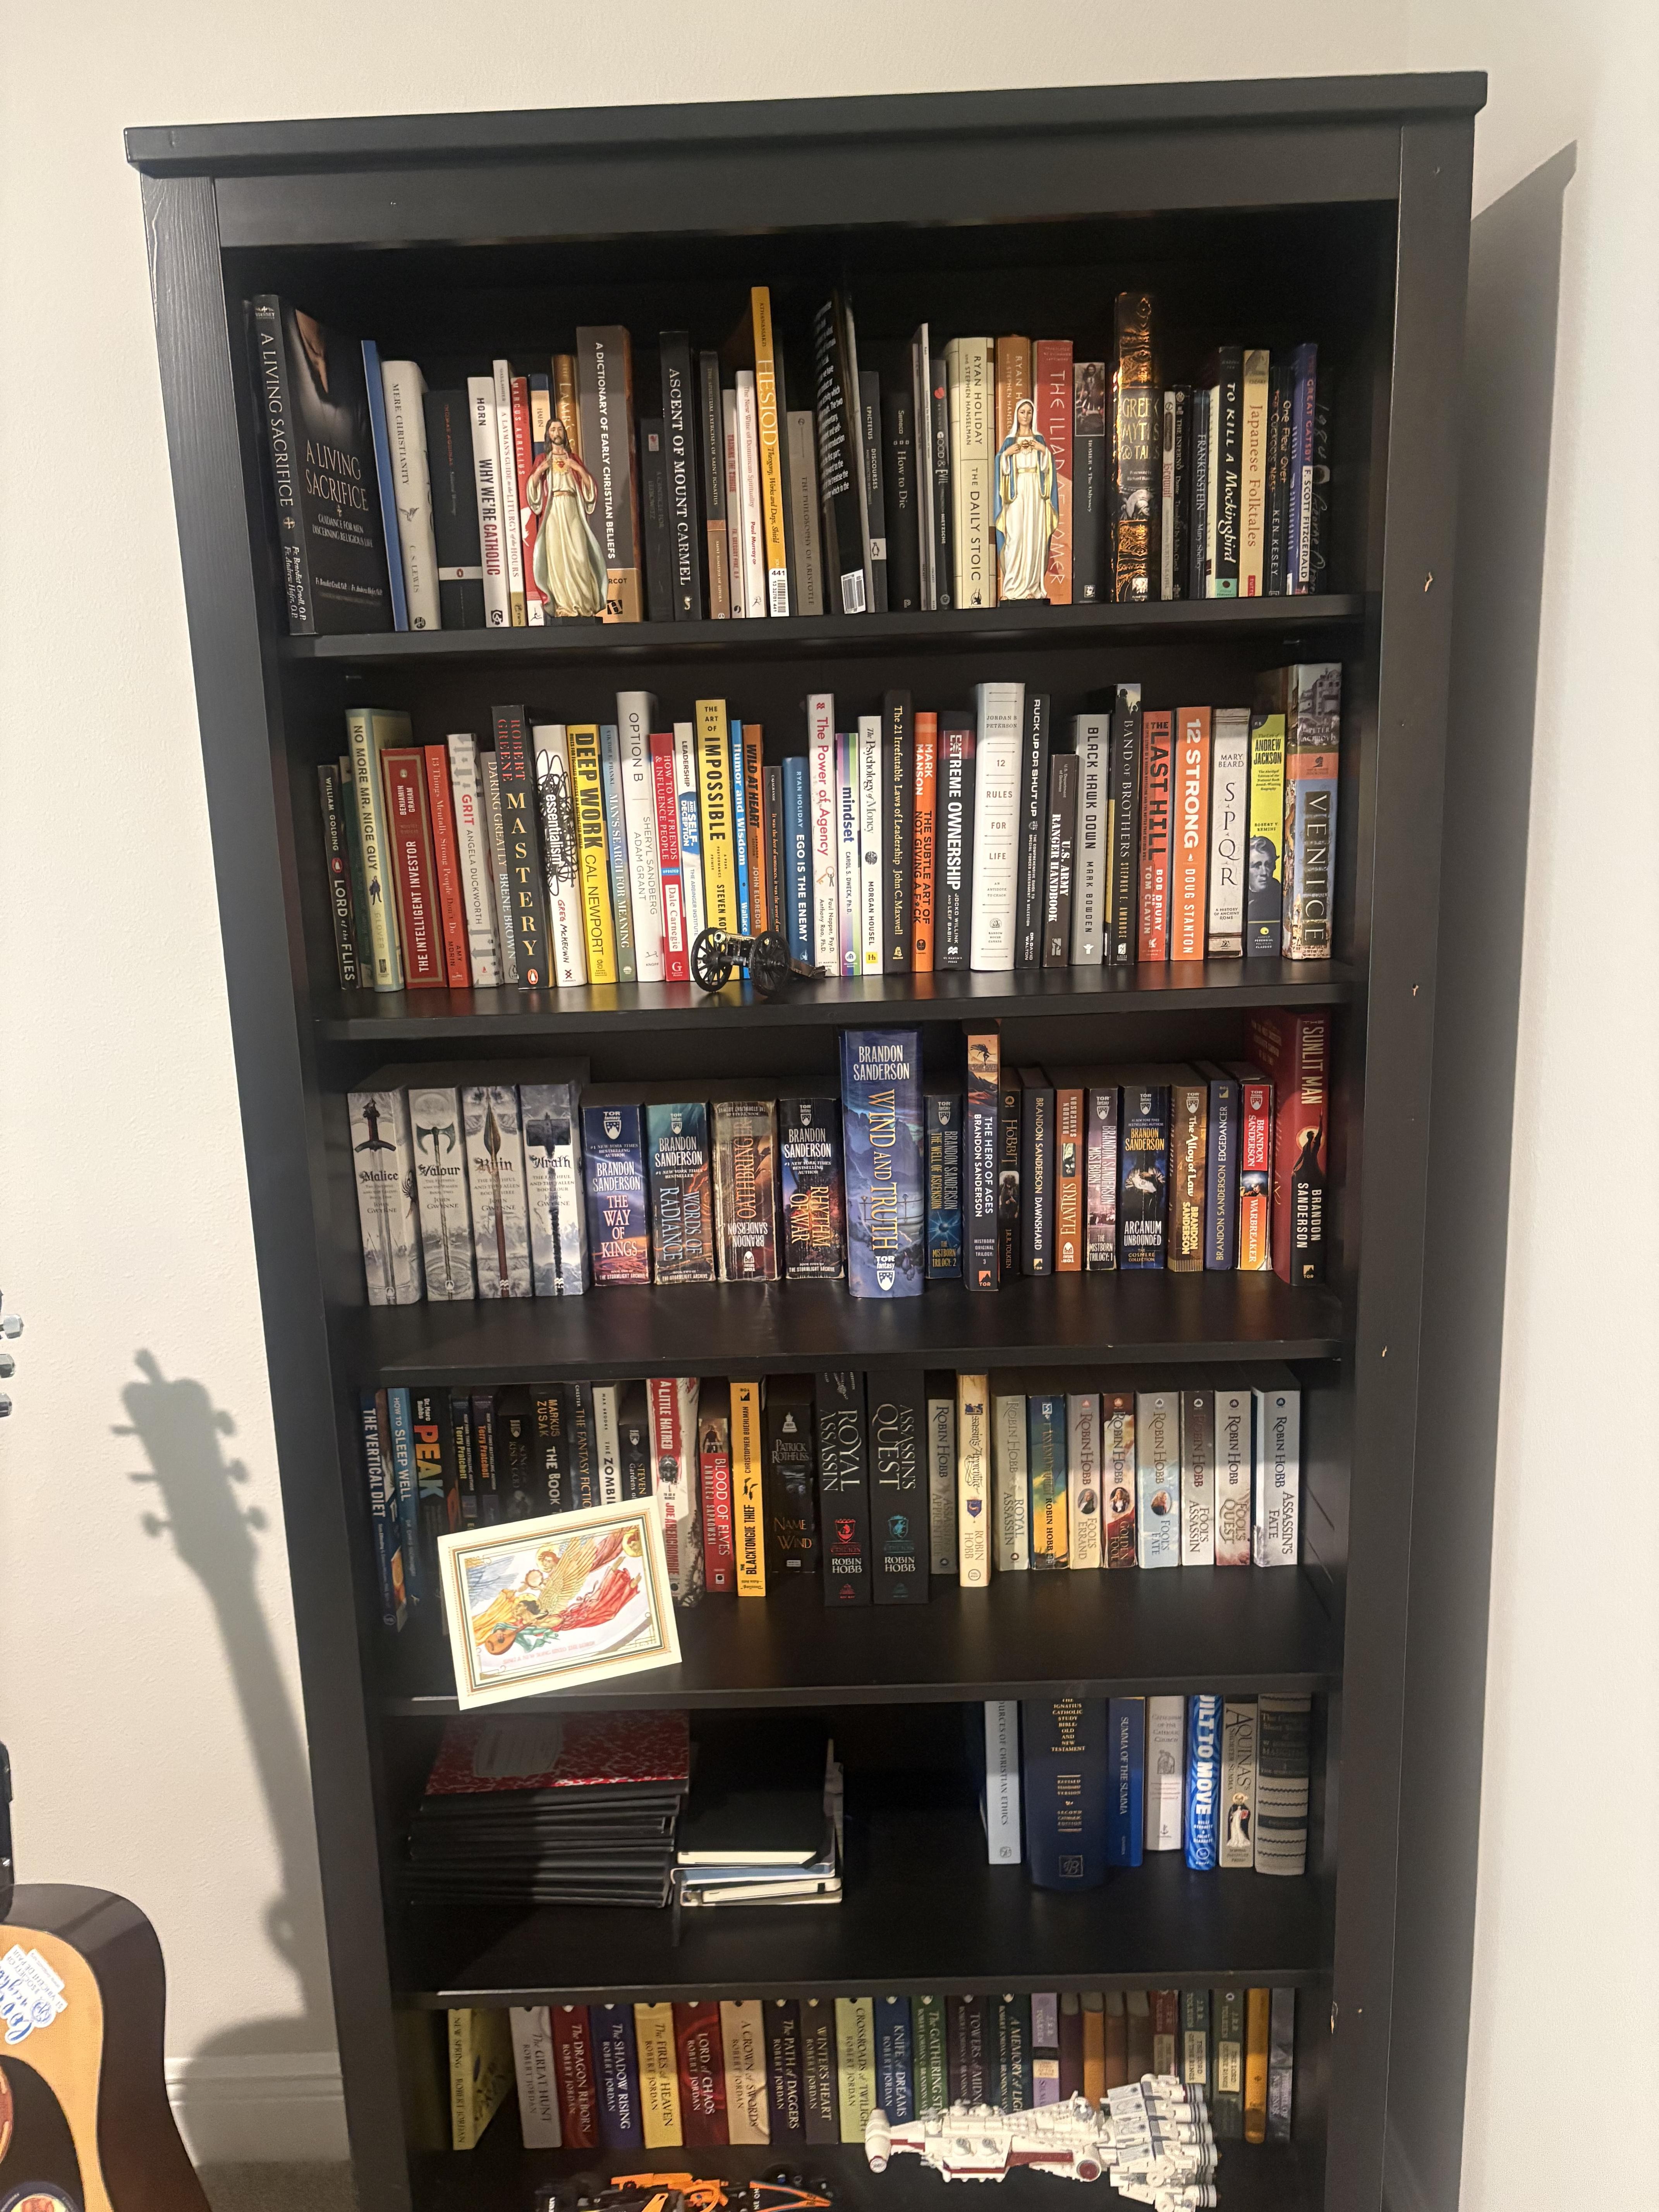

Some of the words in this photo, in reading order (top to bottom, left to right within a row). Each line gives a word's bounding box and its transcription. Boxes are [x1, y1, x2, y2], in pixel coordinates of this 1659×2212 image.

[261, 333, 274, 344] A
[262, 351, 282, 413] LIVING
[392, 384, 402, 412] MERE
[596, 352, 606, 414] DICTIONARY
[1227, 382, 1236, 402] TO
[477, 398, 486, 426] HORN
[669, 369, 683, 431] ASCENT
[757, 359, 778, 446] HESIOD
[600, 416, 608, 429] OF
[1226, 408, 1236, 448] KILL
[1249, 405, 1263, 472] Japanese
[271, 418, 294, 507] SACRIFICE
[395, 413, 409, 486] CHRISTIANITY
[601, 429, 611, 464] EARLY
[672, 436, 684, 455] OF
[897, 451, 907, 472] How
[1226, 453, 1235, 463] A
[479, 459, 492, 484] WHY
[674, 457, 687, 519] MOUNT
[898, 475, 905, 486] to
[1304, 469, 1311, 477] F.
[603, 466, 613, 520] CHRISTIAN
[970, 490, 981, 531] DAILY
[1302, 478, 1310, 508] SCOTT
[1218, 469, 1237, 564] Mockingbird
[1247, 477, 1261, 547] Folktales
[483, 524, 500, 575] CATHOLIC
[605, 522, 615, 559] BELIEFS
[677, 522, 691, 586] CARMEL
[1300, 510, 1310, 578] FITZGERALD
[970, 536, 982, 581] STOIC
[354, 725, 363, 742] NO
[629, 713, 642, 768] OPTION
[816, 717, 828, 740] The
[1187, 718, 1201, 744] 12
[1254, 739, 1281, 752] ANDREW
[575, 733, 596, 783] DEEP
[817, 745, 829, 785] Power
[1087, 727, 1098, 768] BLACK
[1253, 752, 1282, 765] JACKSON
[356, 748, 367, 783] MORE
[634, 773, 643, 782] B
[949, 734, 962, 798] EXTREME
[361, 787, 370, 809] MR.
[704, 737, 722, 840] IMPOSSIBLE
[819, 789, 829, 804] of
[1086, 774, 1097, 809] HAWK
[1183, 749, 1200, 848] STRONG
[364, 812, 374, 840] NICE
[462, 794, 475, 826] GRIT
[579, 788, 603, 849] WORK
[843, 787, 853, 843] mindset
[546, 794, 562, 865] essentialism
[796, 834, 805, 860] EGO
[817, 808, 830, 856] Agency
[947, 802, 962, 890] OWNERSHIP
[1085, 815, 1097, 849] DOWN
[368, 845, 378, 870] GUY
[406, 841, 418, 888] INVESTOR
[466, 830, 476, 866] ANGELA
[506, 793, 537, 955] MASTERY
[586, 855, 596, 883] CAL
[797, 864, 805, 874] IS
[798, 876, 806, 896] THE
[1304, 794, 1327, 945] VENICE
[471, 868, 482, 924] DUCKWORTH
[668, 888, 677, 907] Dale
[334, 880, 348, 917] LORD
[341, 944, 355, 981] FLIES
[413, 891, 426, 944] INTELLIGENT
[587, 886, 604, 955] NEWPORT
[669, 910, 678, 950] Carnegie
[798, 899, 807, 942] ENEMY
[419, 947, 429, 973] THE
[858, 1045, 903, 1063] BRANDON
[1302, 1025, 1324, 1072] SUNLIT
[853, 1063, 910, 1081] SANDERSON
[1301, 1075, 1323, 1104] MAN
[868, 1089, 896, 1148] WIND
[1034, 1097, 1044, 1143] BRANDON
[873, 1152, 892, 1180] AND
[985, 1170, 993, 1185] OF
[1034, 1144, 1043, 1193] SANDERSON
[603, 1210, 630, 1225] WAY
[607, 1195, 629, 1208] THE
[871, 1182, 898, 1250] TRUTH
[985, 1188, 993, 1214] AGES
[612, 1226, 625, 1239] OF
[1034, 1197, 1042, 1250] DAWNSHARD
[1123, 1234, 1162, 1246] UNBOUNDED
[1124, 1221, 1162, 1234] ARCANUM
[1249, 1199, 1258, 1263] WARBREAKER
[601, 1242, 637, 1258] KINGS
[414, 1425, 445, 1499] PEAK
[819, 1409, 838, 1491] ASSASSIN
[838, 1410, 862, 1492] ROYAL
[715, 1458, 727, 1501] BLOOD
[717, 1504, 729, 1526] OF
[744, 1505, 755, 1527] THIEF
[1268, 1509, 1278, 1539] FATE
[718, 1529, 730, 1556] ELVES
[745, 1529, 757, 1575] BLACKTONGUE
[1120, 1717, 1129, 1748] SUMMA
[1199, 1695, 1215, 1736] UILT
[1120, 1750, 1128, 1762] OF
[1197, 1740, 1213, 1758] TO
[1119, 1782, 1128, 1815] SUMMA
[1195, 1762, 1213, 1815] MOVE
[612, 2024, 623, 2040] The
[894, 2025, 905, 2057] KNIFE
[603, 2041, 612, 2073] ROBERT
[615, 2041, 627, 2091] SHADOW
[898, 2059, 902, 2069] of
[606, 2076, 615, 2111] JORDAN
[619, 2093, 631, 2129] RISING
[894, 2071, 907, 2117] DREAMS
